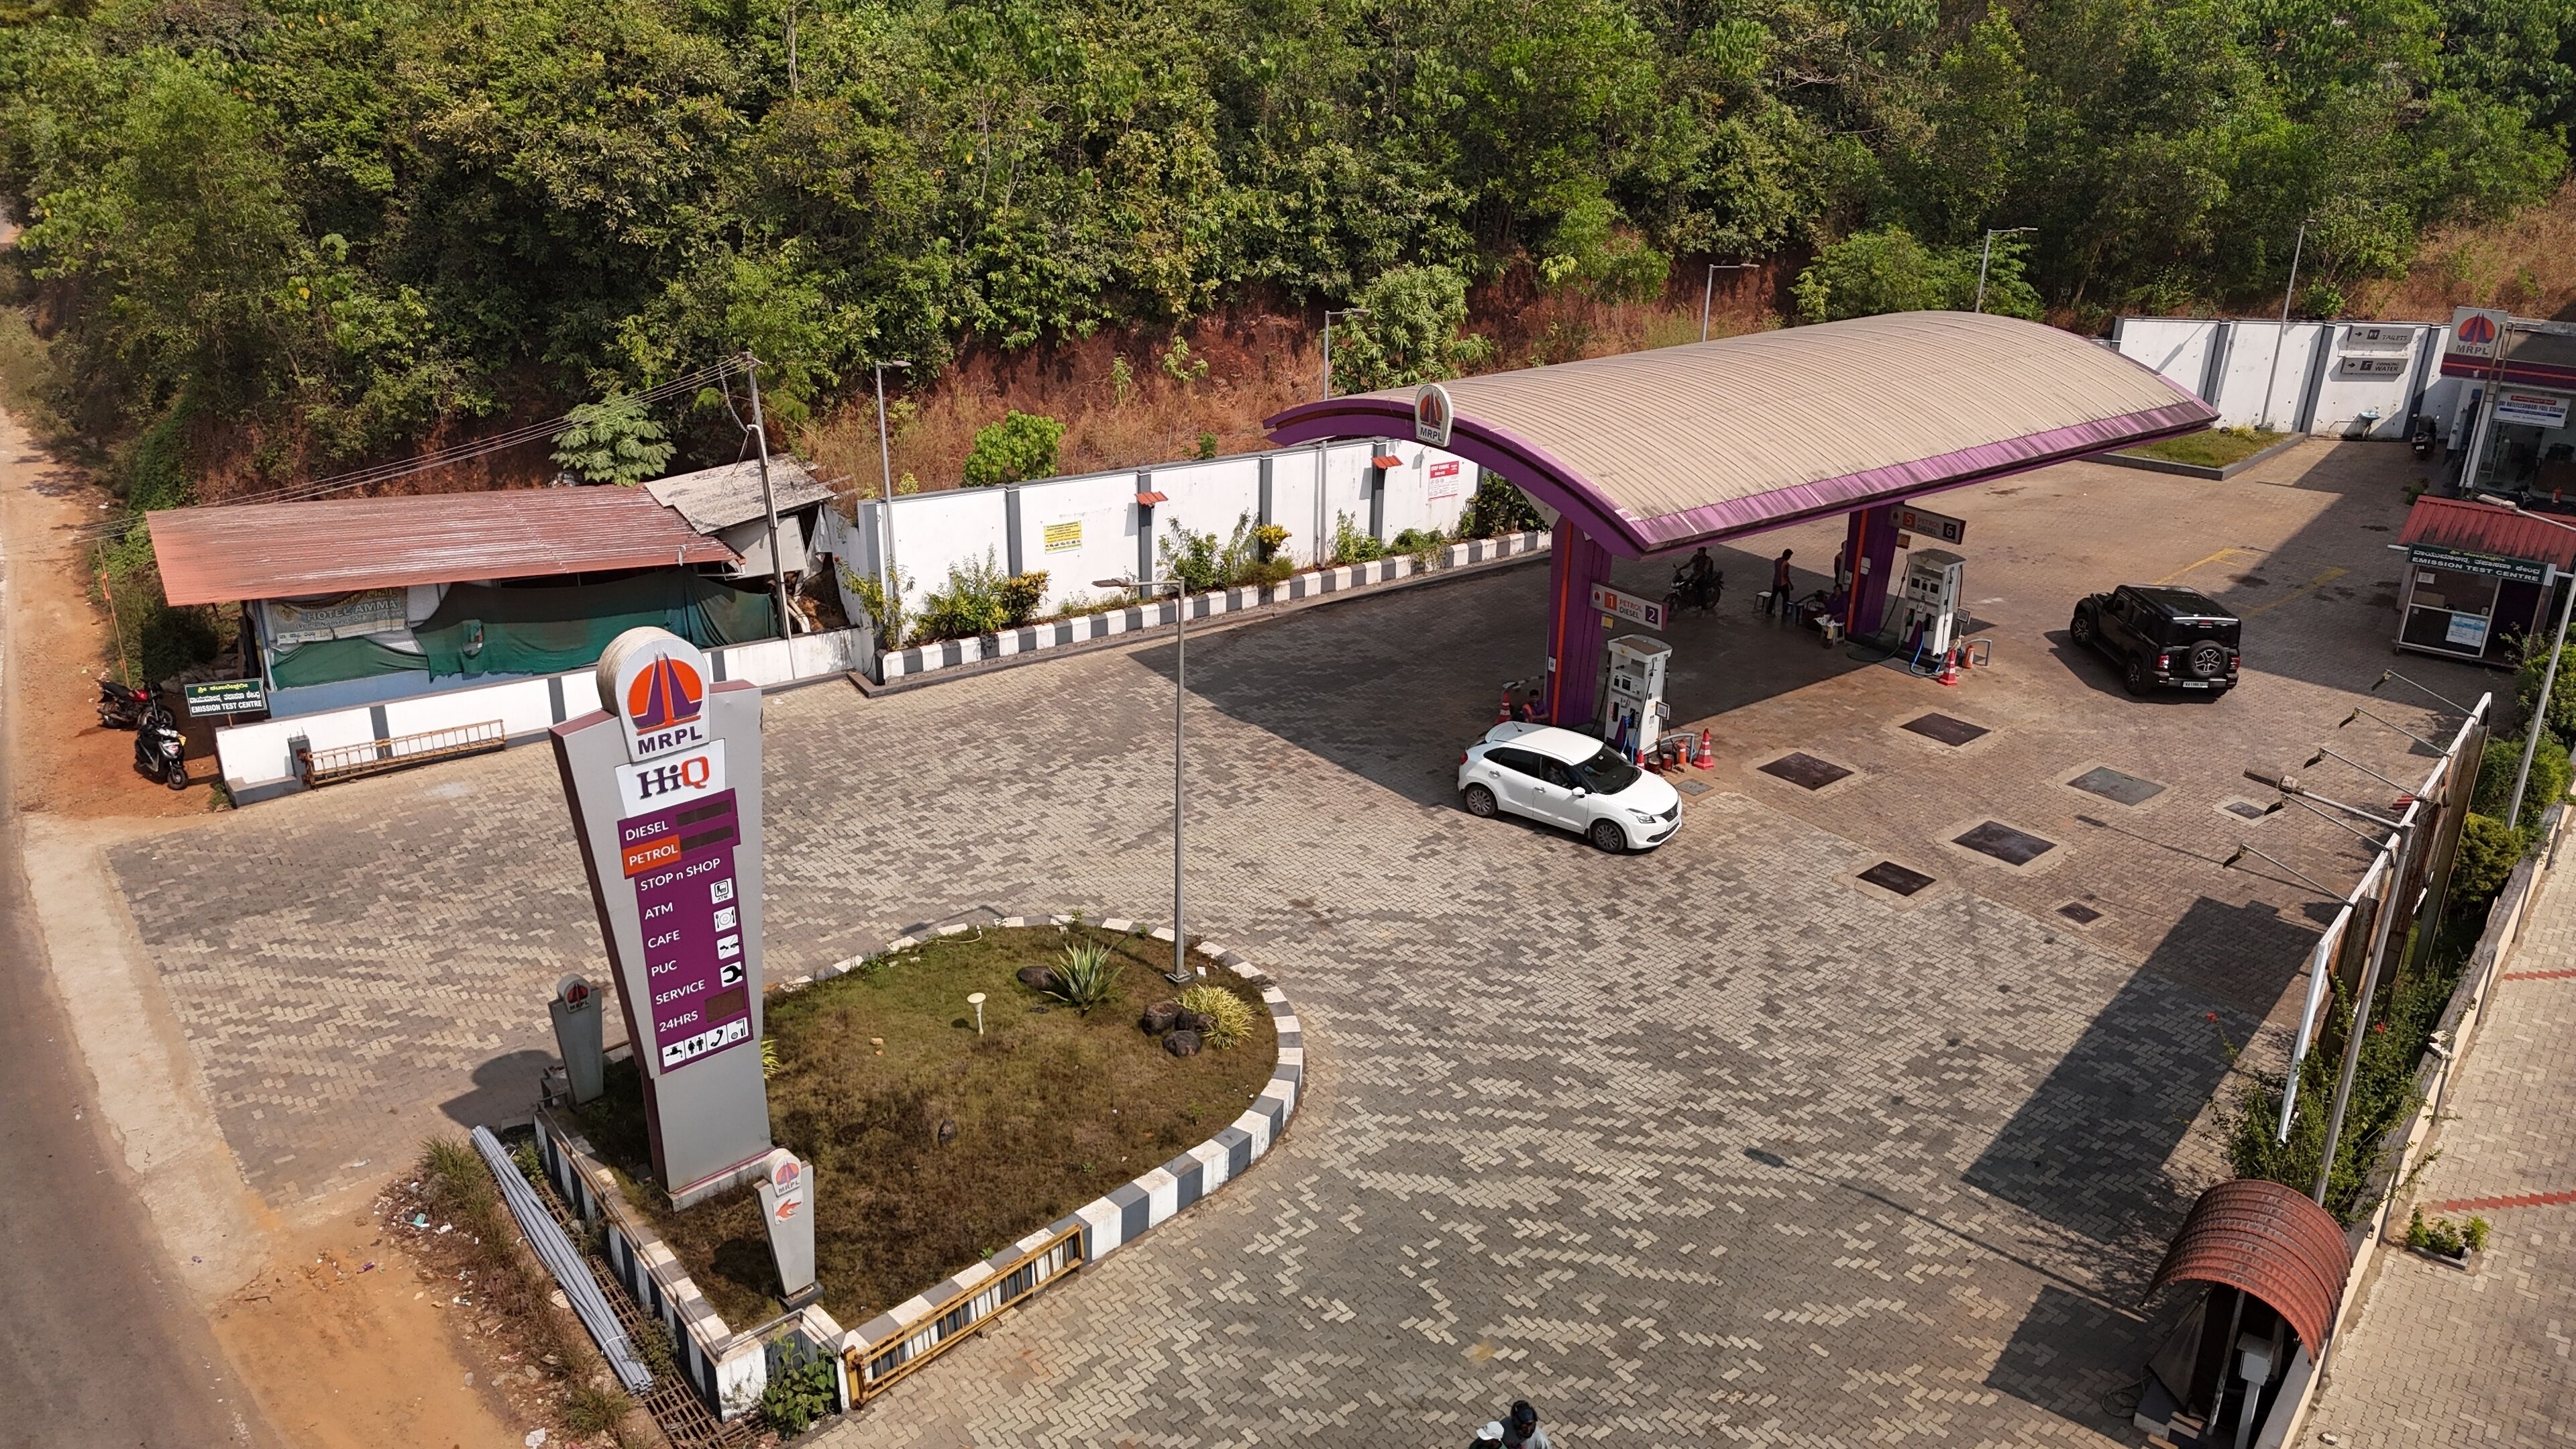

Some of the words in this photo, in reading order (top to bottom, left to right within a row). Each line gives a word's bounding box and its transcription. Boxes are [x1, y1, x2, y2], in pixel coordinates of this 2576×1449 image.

[2455, 343, 2490, 356] MRPL
[1420, 426, 1442, 442] MRPL
[1917, 517, 1941, 529] PETROL
[1917, 525, 1937, 535] DIESEL
[1946, 525, 1953, 537] 6
[2412, 557, 2463, 570] EMISSION
[2466, 564, 2493, 574] TEST
[2496, 570, 2539, 582] CENTRE
[1609, 595, 1613, 607] 1
[1619, 598, 1643, 612] PETROL
[306, 606, 352, 621] HOTEL
[354, 599, 398, 614] AMMA
[1619, 606, 1639, 619] DIESEL
[1648, 608, 1656, 622] 2
[191, 704, 221, 713] EMISSION
[221, 702, 237, 710] TEST
[238, 700, 263, 709] CENTRE
[637, 726, 703, 755] MRPL
[637, 755, 710, 800] HiQ
[625, 820, 669, 841] DIESEL
[629, 844, 678, 867] PETROL
[640, 871, 674, 891] STOP
[676, 871, 684, 881] n
[686, 857, 721, 877] SHOP
[645, 902, 674, 920] ATM
[647, 930, 681, 949] CAFE
[651, 960, 678, 977] PUC
[655, 979, 706, 1005] SERVICE
[570, 1000, 589, 1011] MRPL
[659, 1010, 698, 1032] 24HRS
[778, 1180, 800, 1193] MRPL
